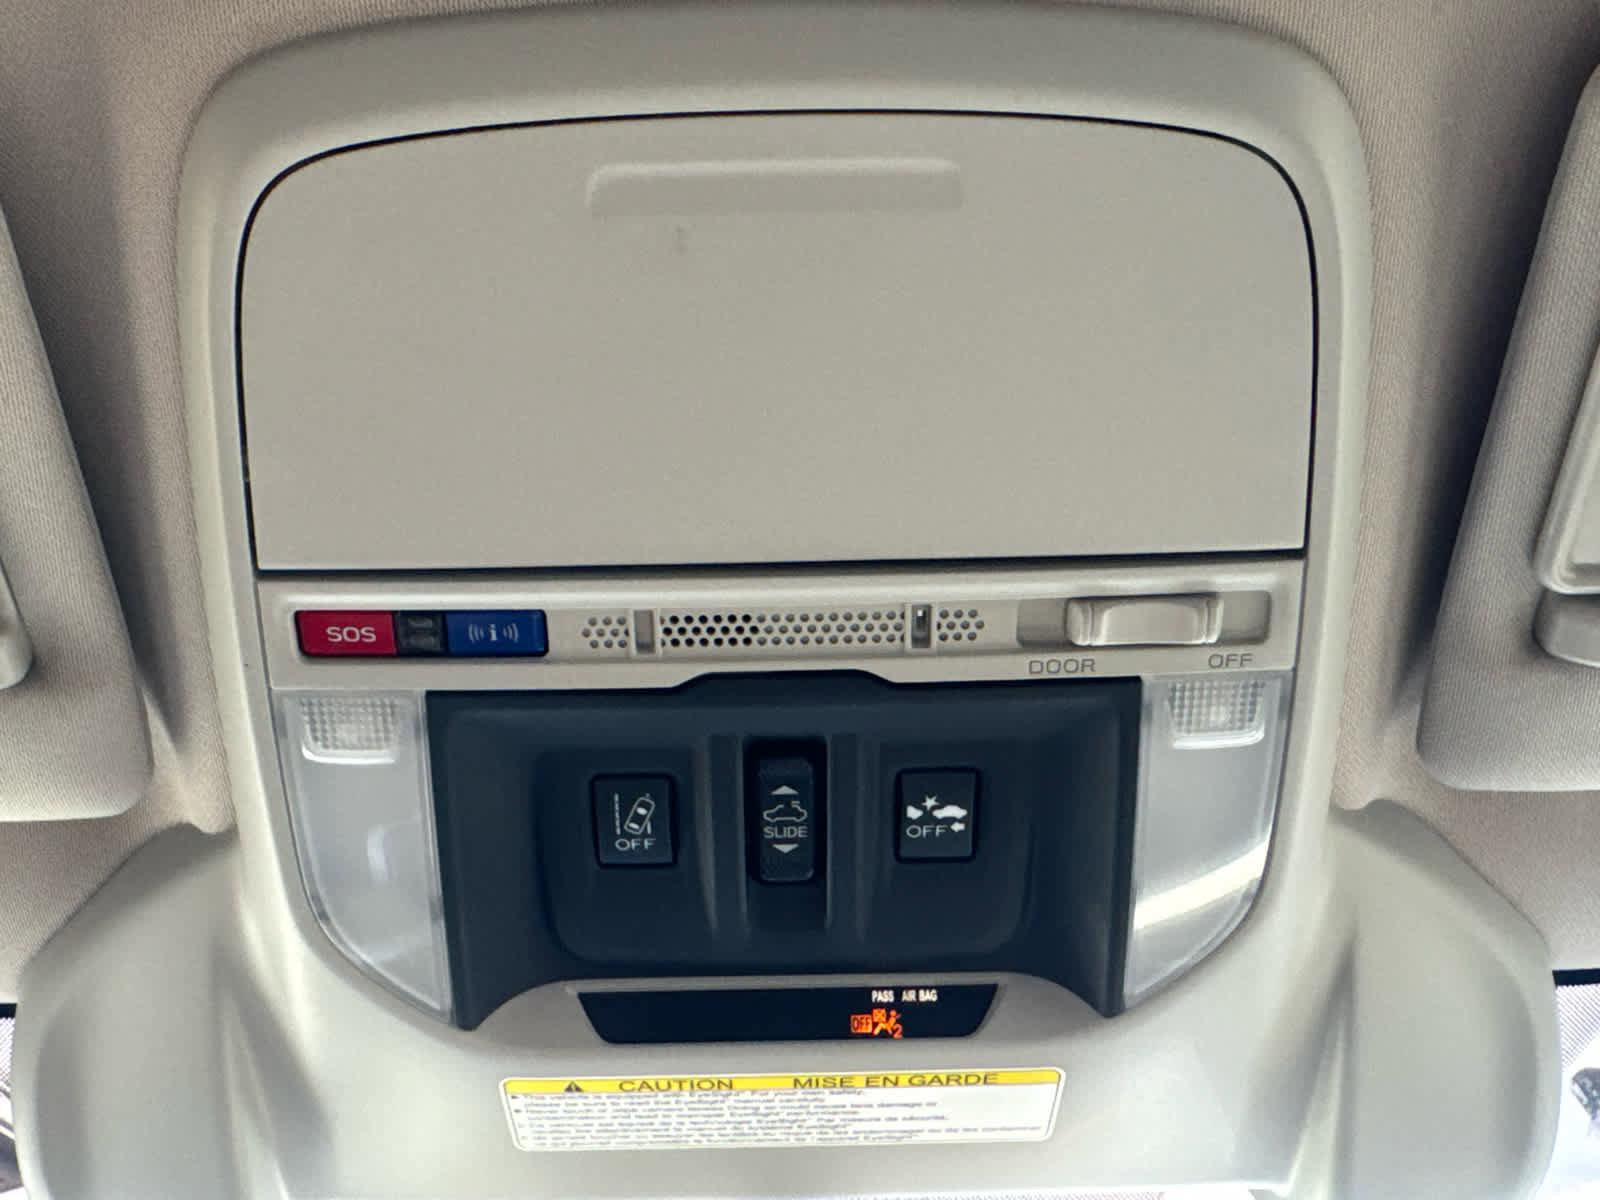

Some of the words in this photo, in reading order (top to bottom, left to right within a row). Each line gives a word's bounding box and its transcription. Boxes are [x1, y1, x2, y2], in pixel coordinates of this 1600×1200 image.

[325, 626, 377, 643] SOS
[1028, 658, 1096, 675] DOOR
[1207, 653, 1254, 669] OFF
[763, 826, 809, 839] SLIDE
[906, 824, 948, 839] OFF
[615, 838, 656, 851] OFF
[871, 989, 895, 1003] PASS
[902, 988, 917, 1002] AIR
[918, 988, 938, 1002] BAG
[852, 1015, 871, 1032] OFF
[618, 1078, 733, 1092] CAUTION
[792, 1076, 855, 1089] MISE
[865, 1075, 899, 1088] EN
[908, 1072, 1000, 1087] GARDE
